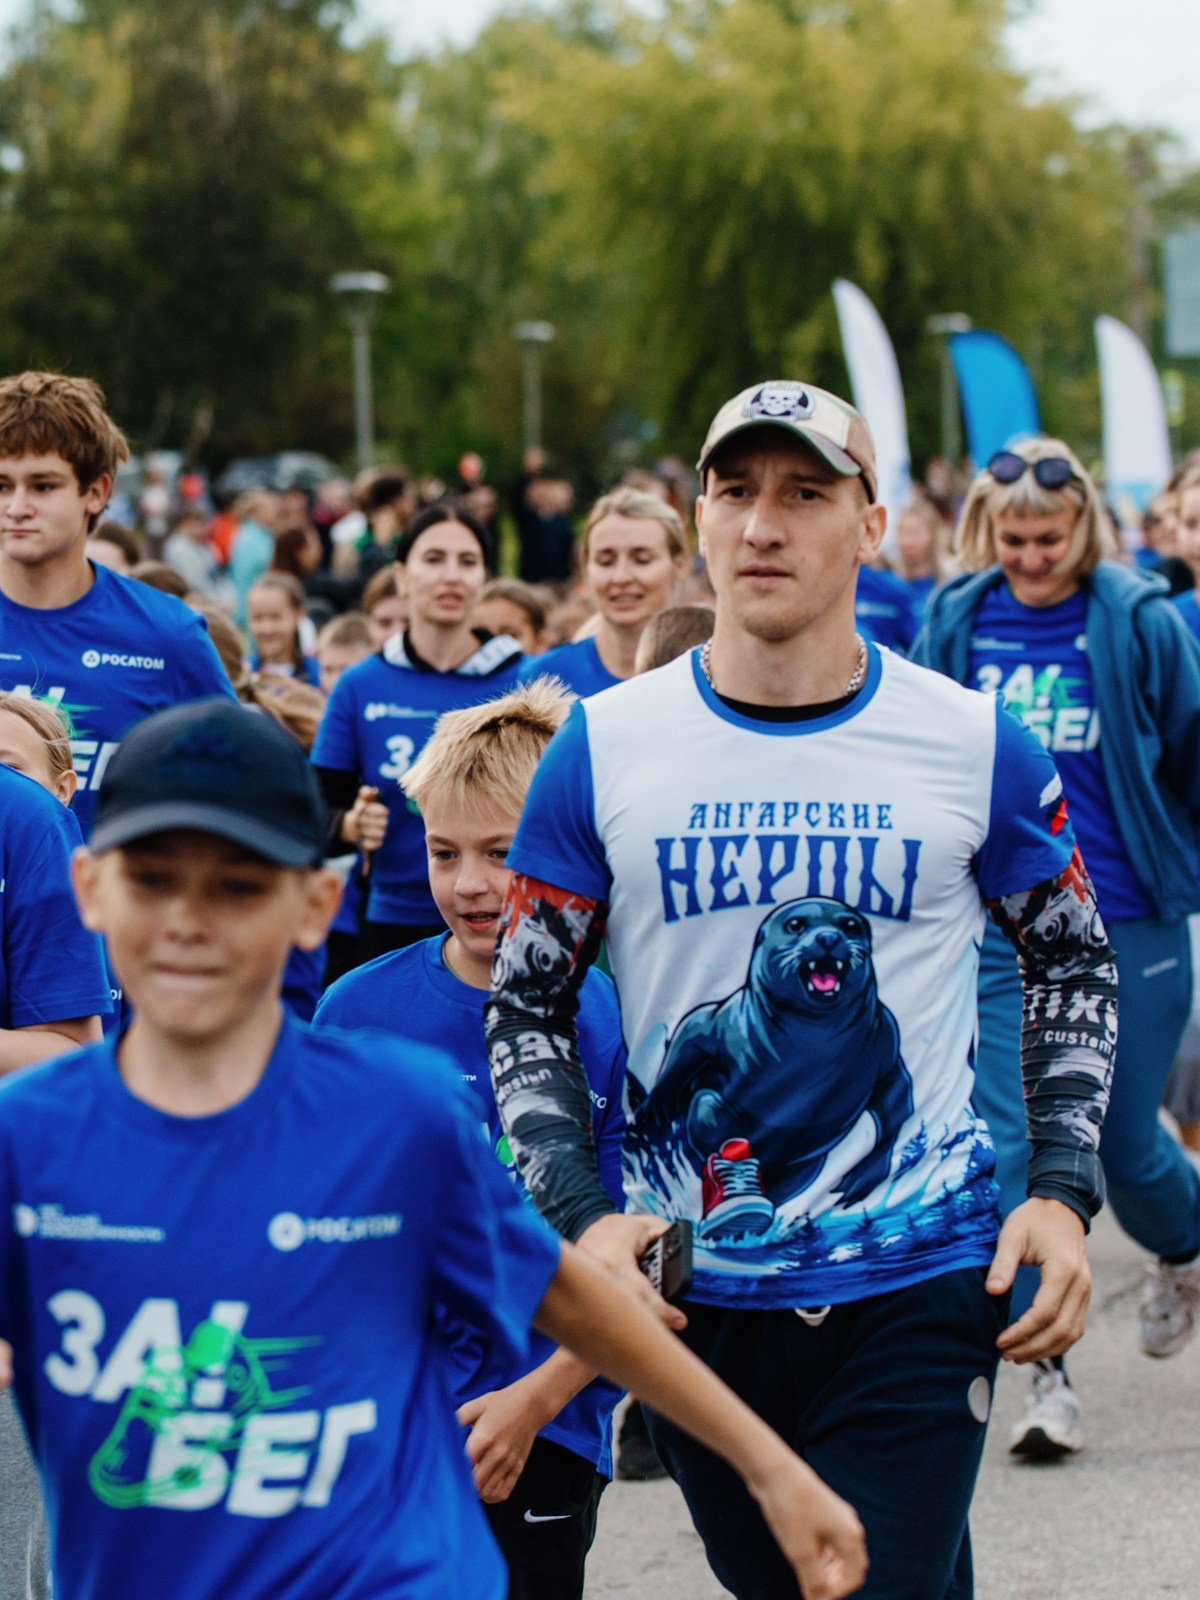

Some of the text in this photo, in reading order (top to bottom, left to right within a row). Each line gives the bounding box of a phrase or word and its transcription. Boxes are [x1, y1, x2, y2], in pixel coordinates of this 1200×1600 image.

[101, 653, 165, 671] РОСАТОМ
[687, 801, 894, 830] АНГАРСКИЕ
[655, 834, 923, 924] НЕРПЫ
[1043, 1029, 1113, 1055] custom
[303, 1213, 403, 1243] РОСАТОМ
[43, 1288, 249, 1408] ЗА!
[145, 1398, 377, 1518] БЕГ
